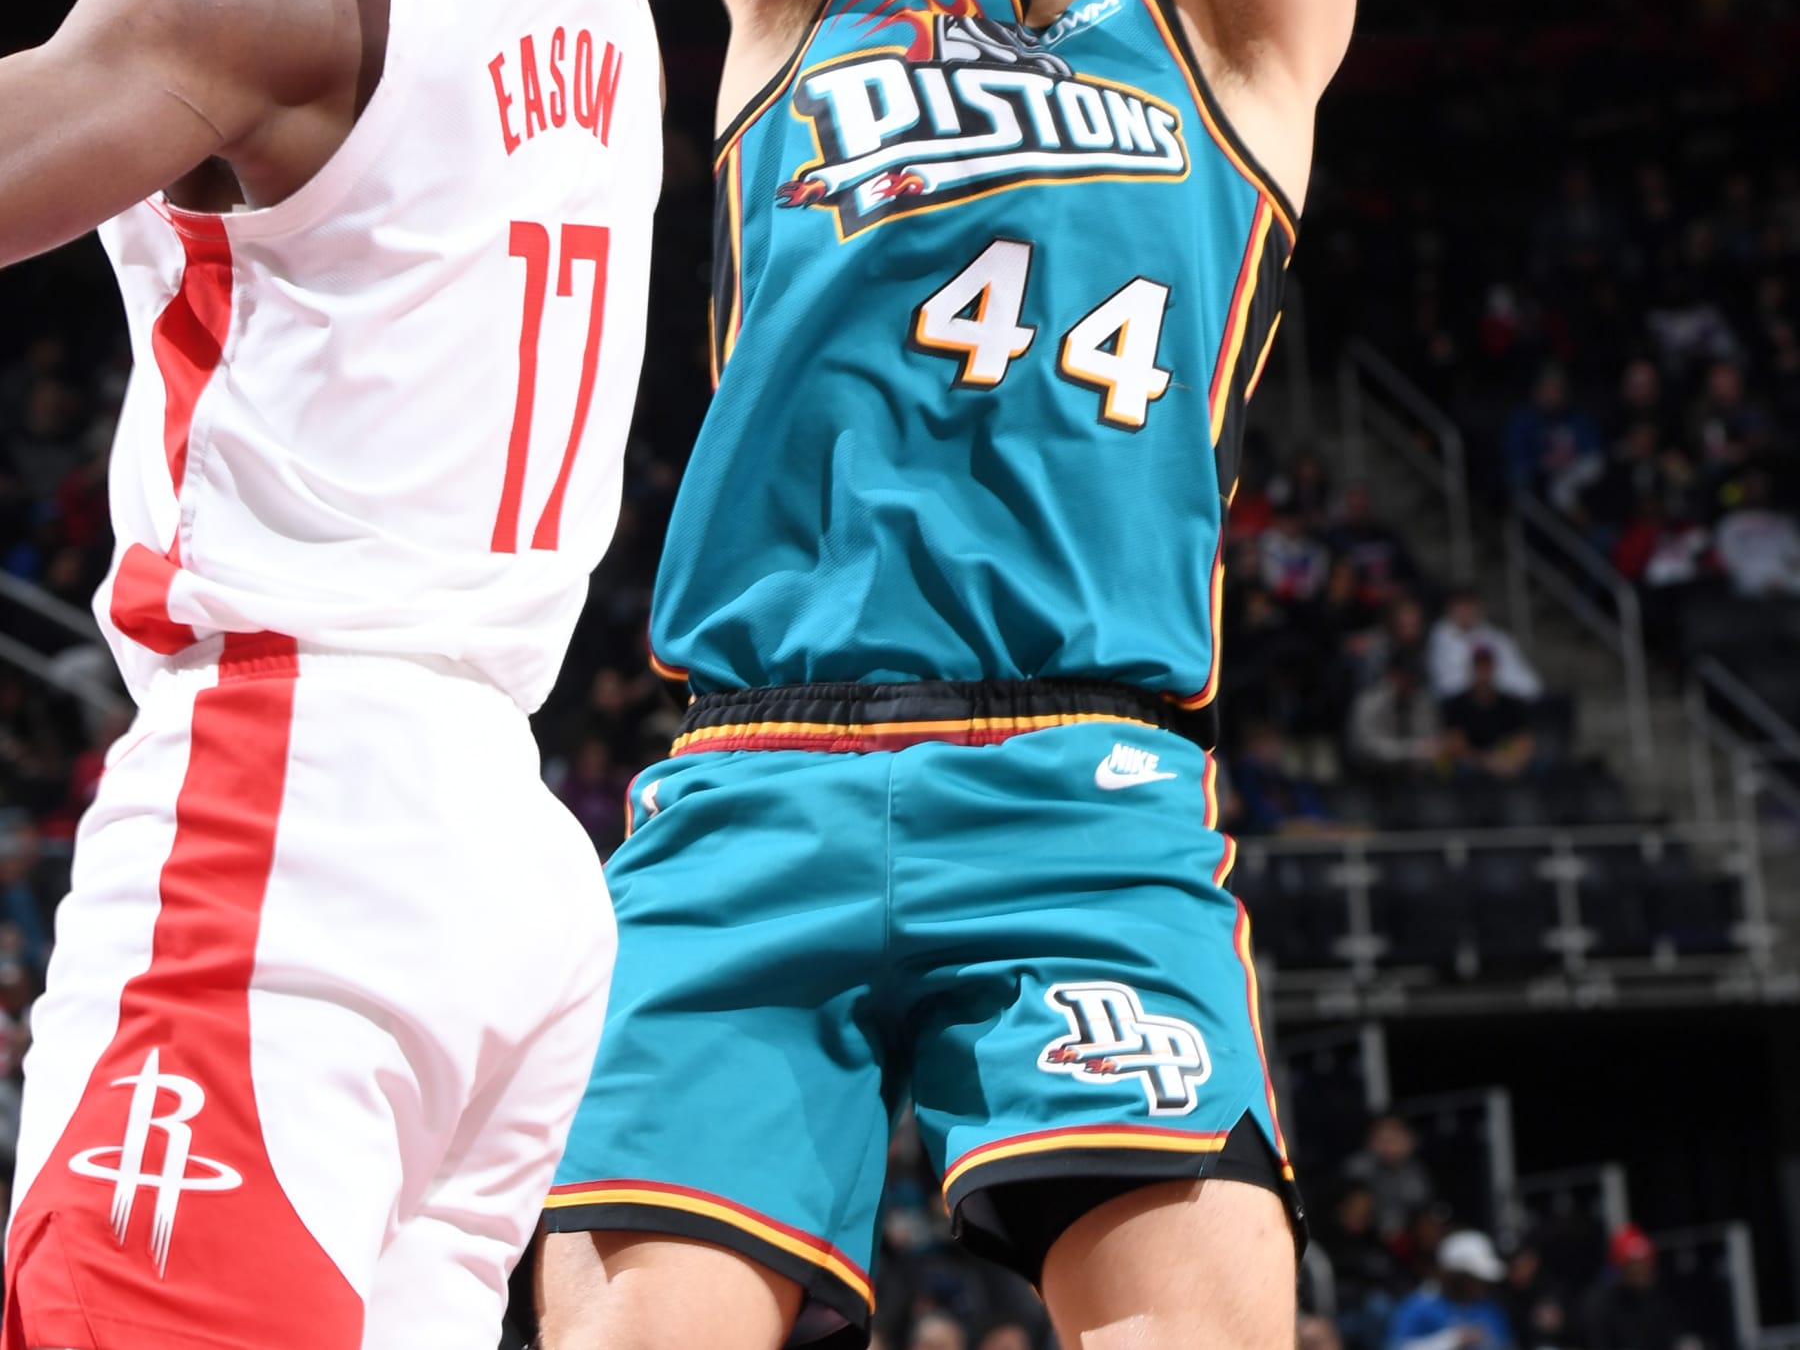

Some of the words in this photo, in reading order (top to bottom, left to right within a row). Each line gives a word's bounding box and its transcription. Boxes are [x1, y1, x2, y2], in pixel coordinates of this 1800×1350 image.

[487, 26, 623, 156] EASON
[796, 53, 1189, 222] PISTONS
[490, 220, 610, 554] 17
[908, 237, 1171, 432] 44
[1107, 742, 1160, 775] NIKE
